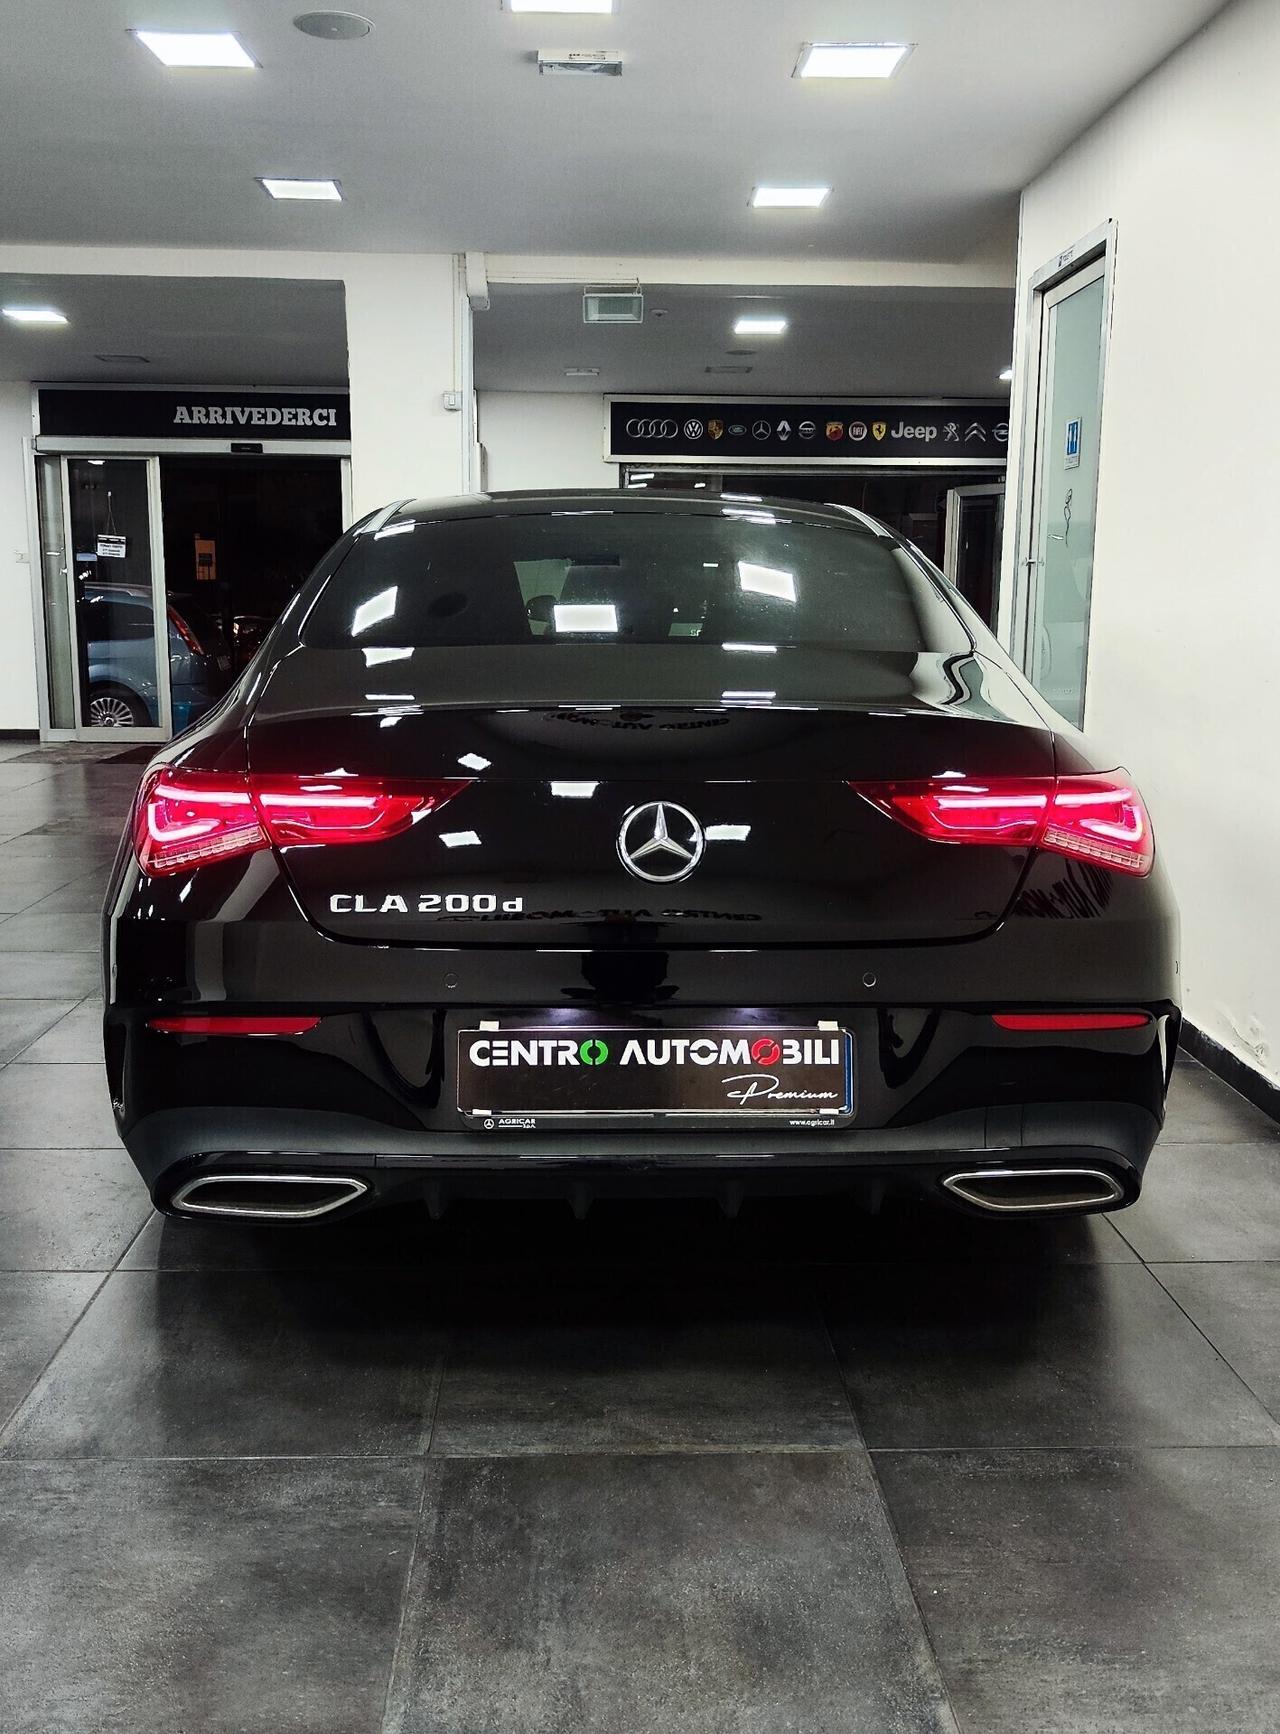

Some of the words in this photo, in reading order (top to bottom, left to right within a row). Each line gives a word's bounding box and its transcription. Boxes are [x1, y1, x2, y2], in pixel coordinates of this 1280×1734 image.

[174, 406, 337, 427] ARRIVEDERCI
[891, 421, 938, 442] Jeep
[329, 893, 409, 914] CLA
[469, 1039, 609, 1067] CENTRO
[620, 1039, 840, 1066] AUTOMOBILI
[721, 1073, 839, 1105] Premium
